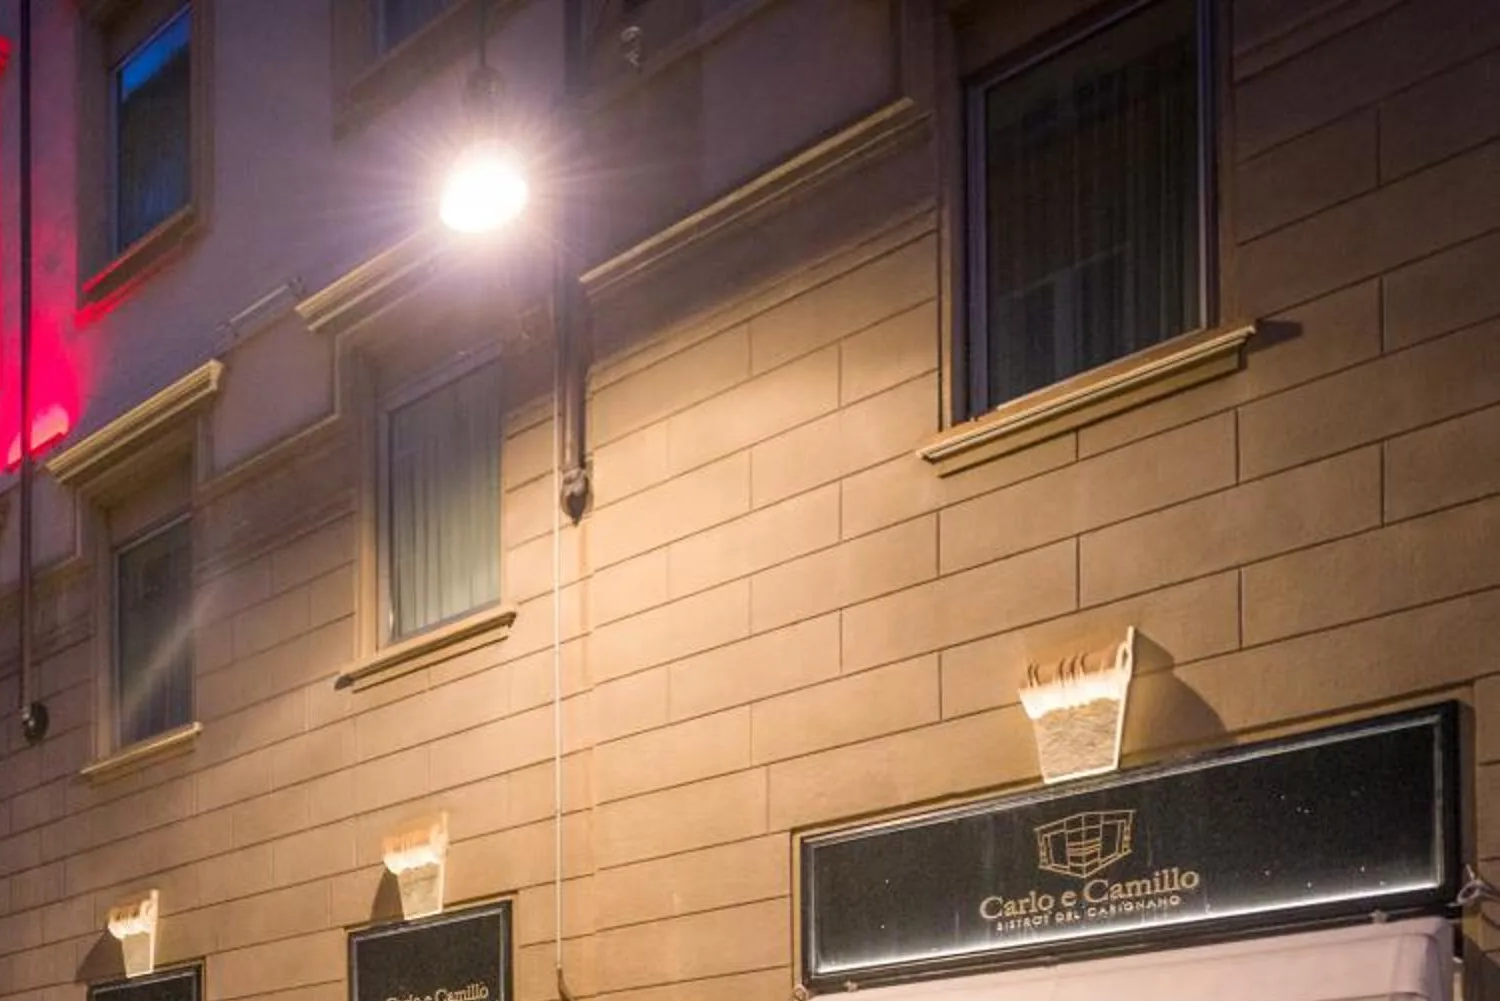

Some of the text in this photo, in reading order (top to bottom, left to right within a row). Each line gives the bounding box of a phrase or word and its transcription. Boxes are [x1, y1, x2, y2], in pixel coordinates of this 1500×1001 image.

[979, 867, 1199, 919] Carlo e Camillo
